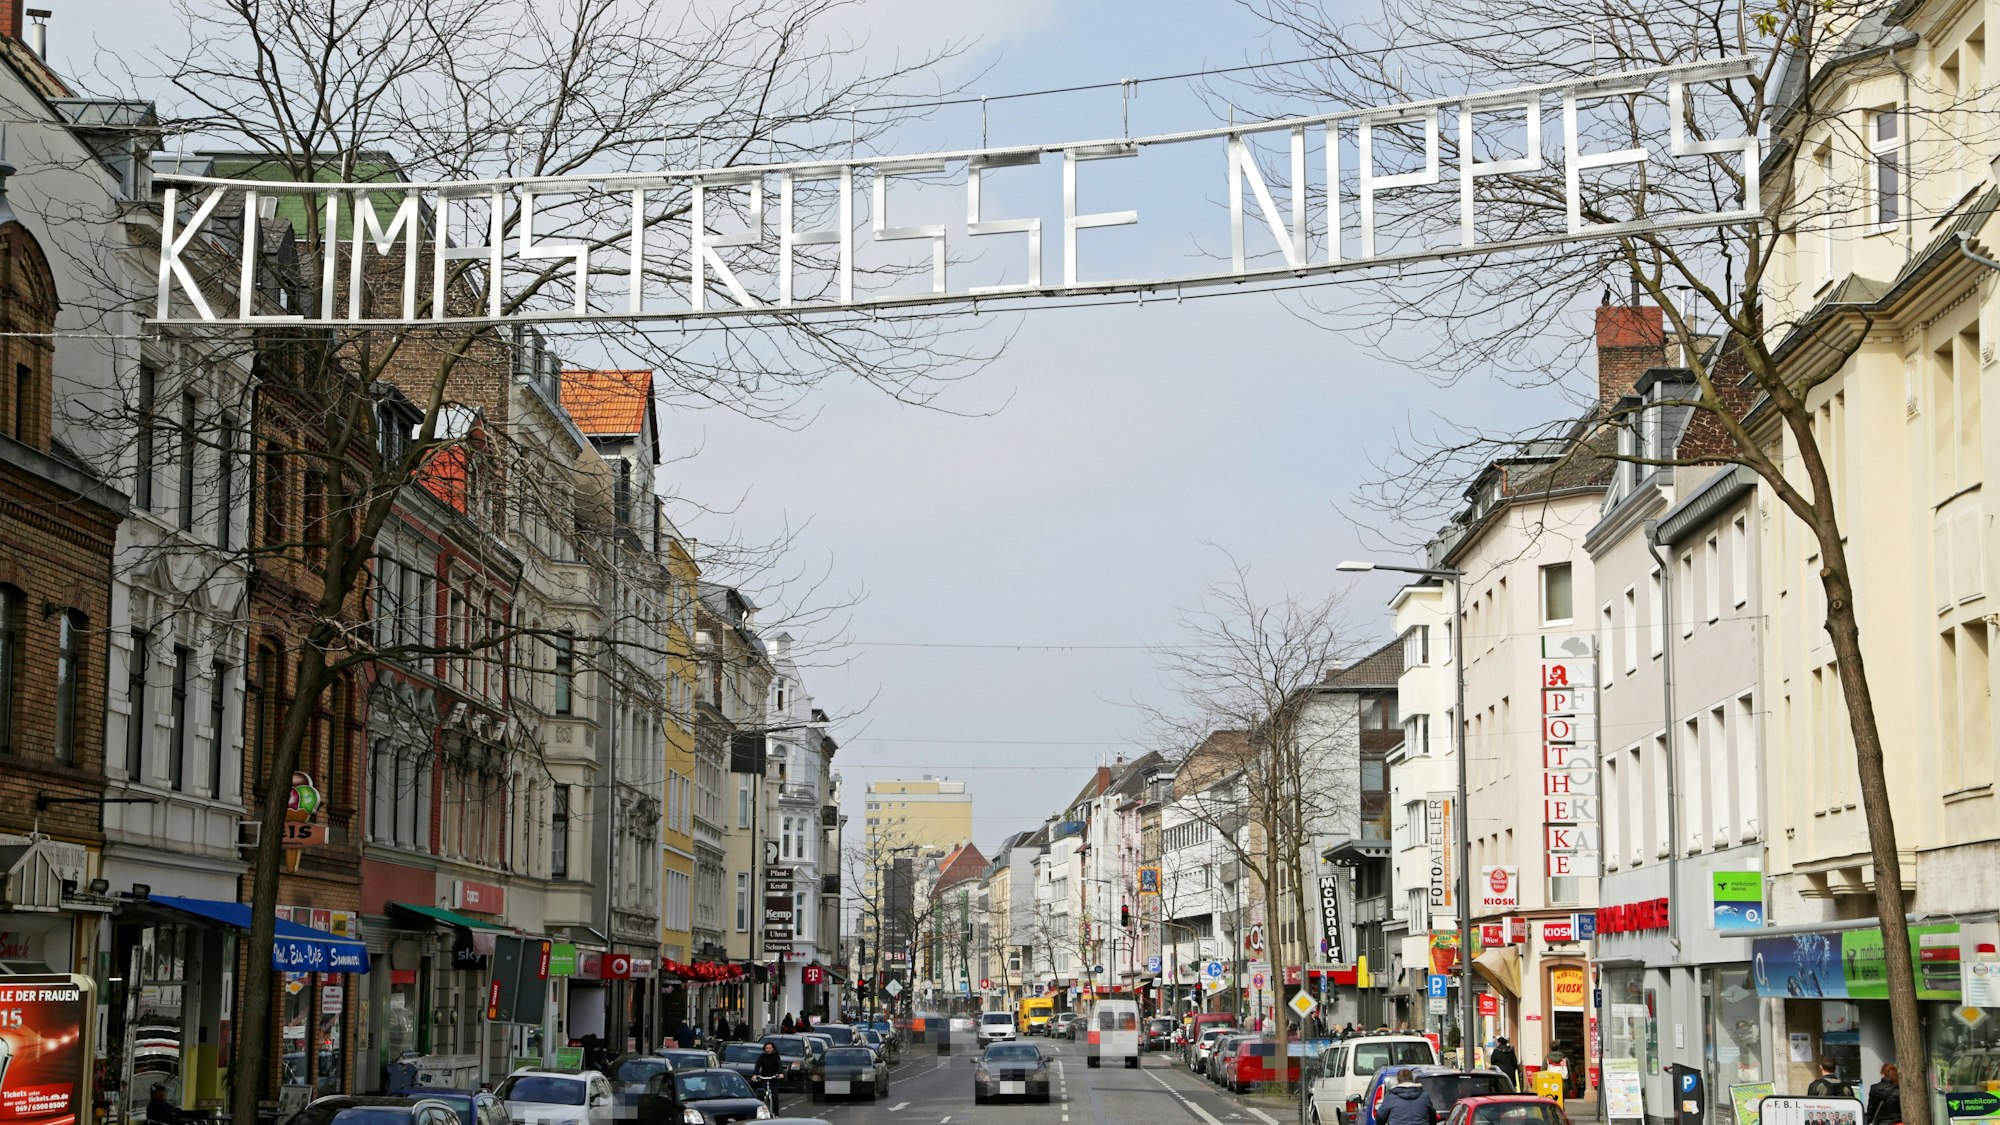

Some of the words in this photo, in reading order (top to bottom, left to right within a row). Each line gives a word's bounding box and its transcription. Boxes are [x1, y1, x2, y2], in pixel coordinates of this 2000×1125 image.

[1229, 57, 1760, 273] NIPPES
[1548, 664, 1571, 875] APOTHEKE
[1430, 800, 1443, 907] FOTOATELIER
[770, 869, 790, 877] Pfand-
[770, 882, 788, 890] Kredit
[1483, 897, 1515, 906] KIOSK
[766, 909, 792, 920] Kemp
[1544, 927, 1572, 937] KIOSK
[457, 947, 482, 963] sky
[1861, 944, 1884, 960] mobilco
[1556, 983, 1583, 994] KIOSK
[16, 990, 36, 1002] DER
[39, 989, 80, 1002] FRAUEN
[1682, 1075, 1694, 1091] P
[3, 1090, 27, 1099] Tickets
[28, 1093, 69, 1103] tickets.dfb.de
[1774, 1101, 1781, 1109] F.
[1783, 1101, 1792, 1109] B.
